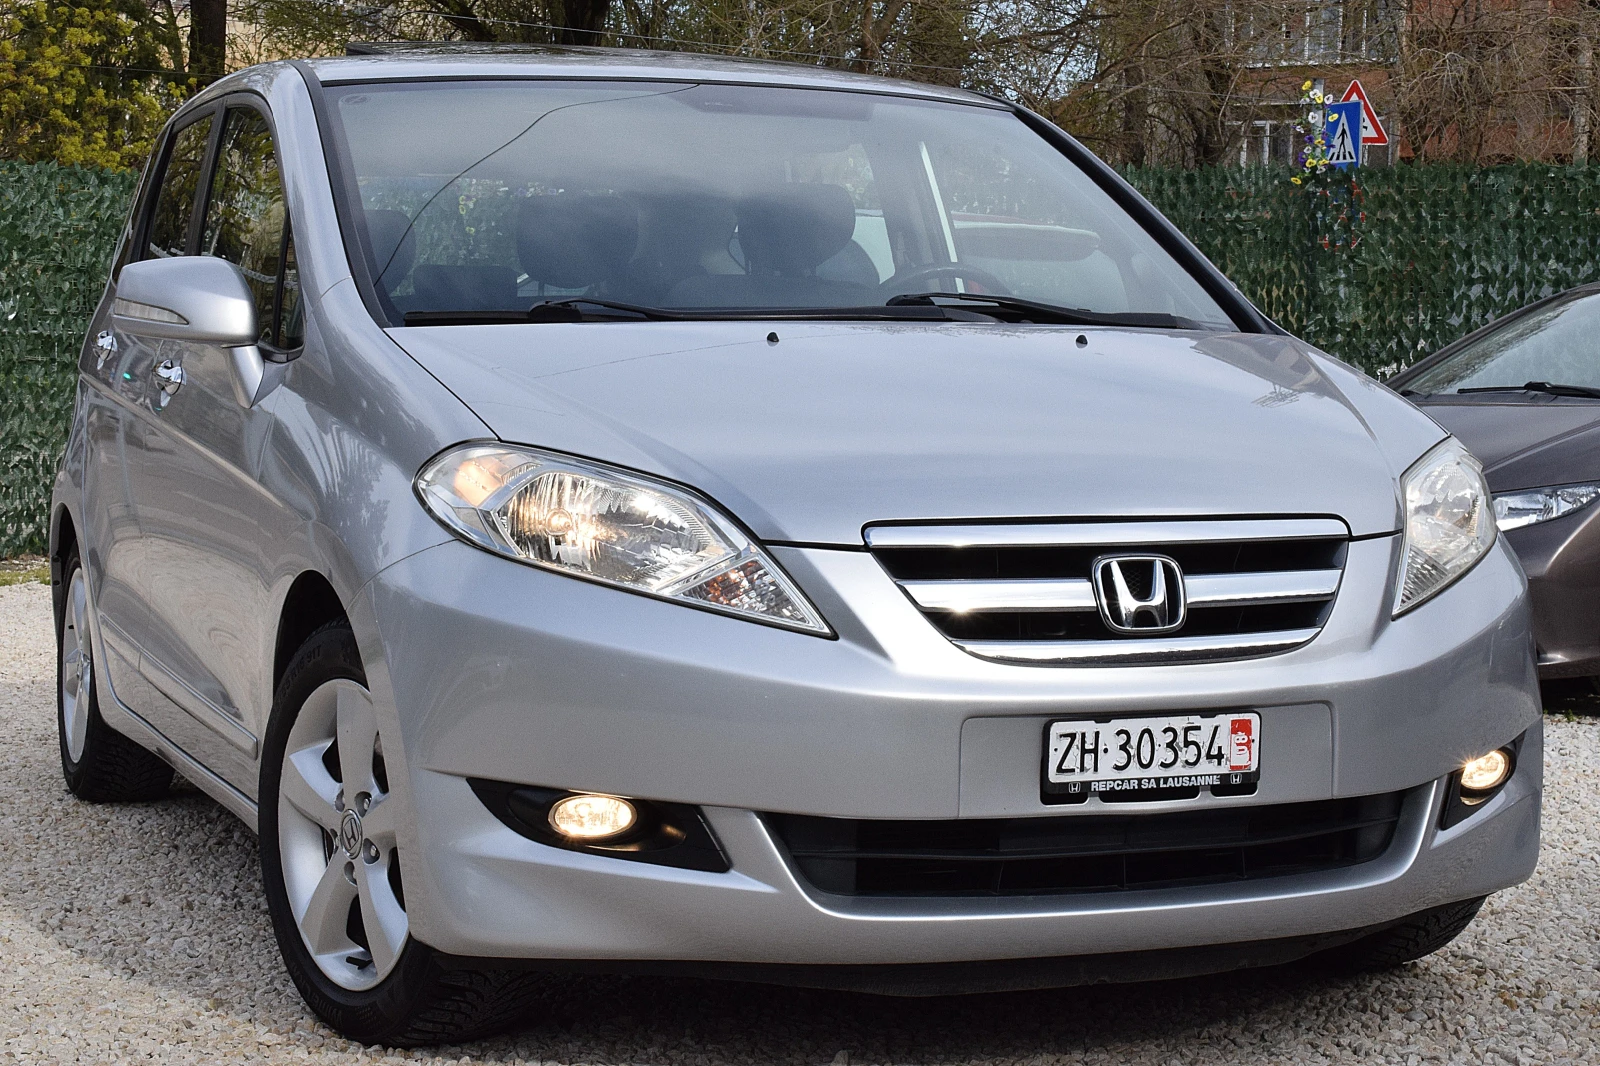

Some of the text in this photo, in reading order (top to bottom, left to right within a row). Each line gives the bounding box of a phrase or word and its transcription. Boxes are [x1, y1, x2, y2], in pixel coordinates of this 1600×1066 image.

[1090, 779, 1139, 792] REPCAR
[1140, 778, 1157, 789] SA
[1159, 774, 1221, 788] LAUSANNE
